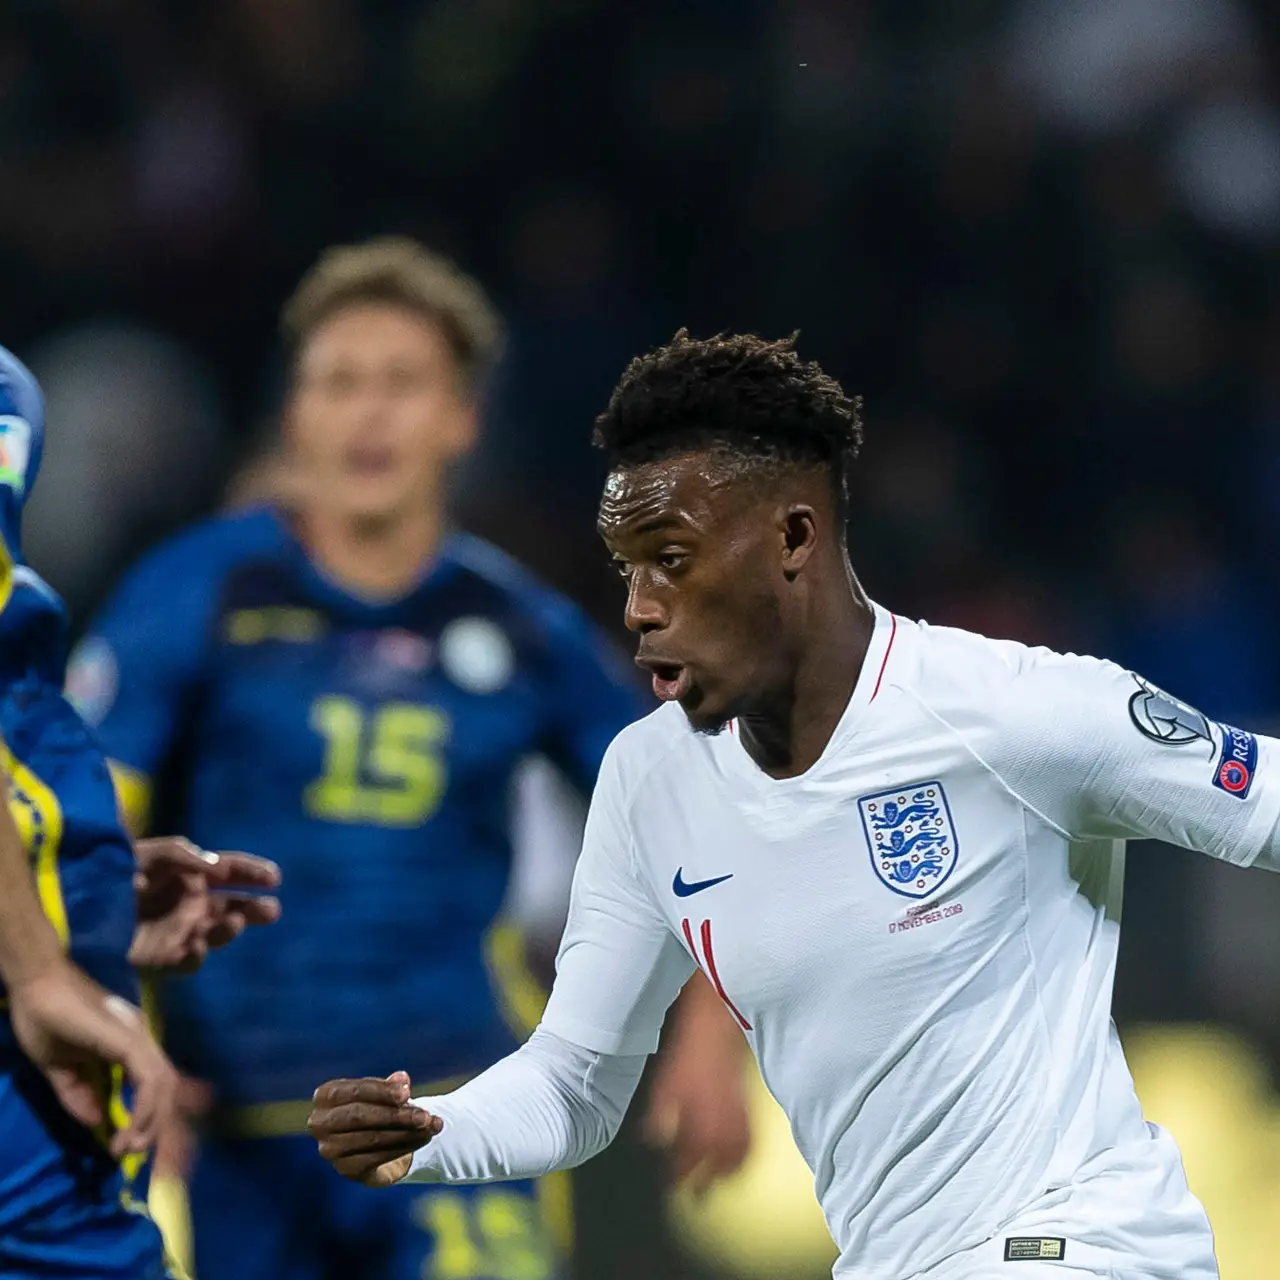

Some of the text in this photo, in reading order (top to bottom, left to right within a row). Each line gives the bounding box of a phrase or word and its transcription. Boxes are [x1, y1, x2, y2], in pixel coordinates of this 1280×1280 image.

[306, 694, 448, 828] 15
[1231, 729, 1251, 761] RES
[898, 911, 943, 931] NOVEMBER
